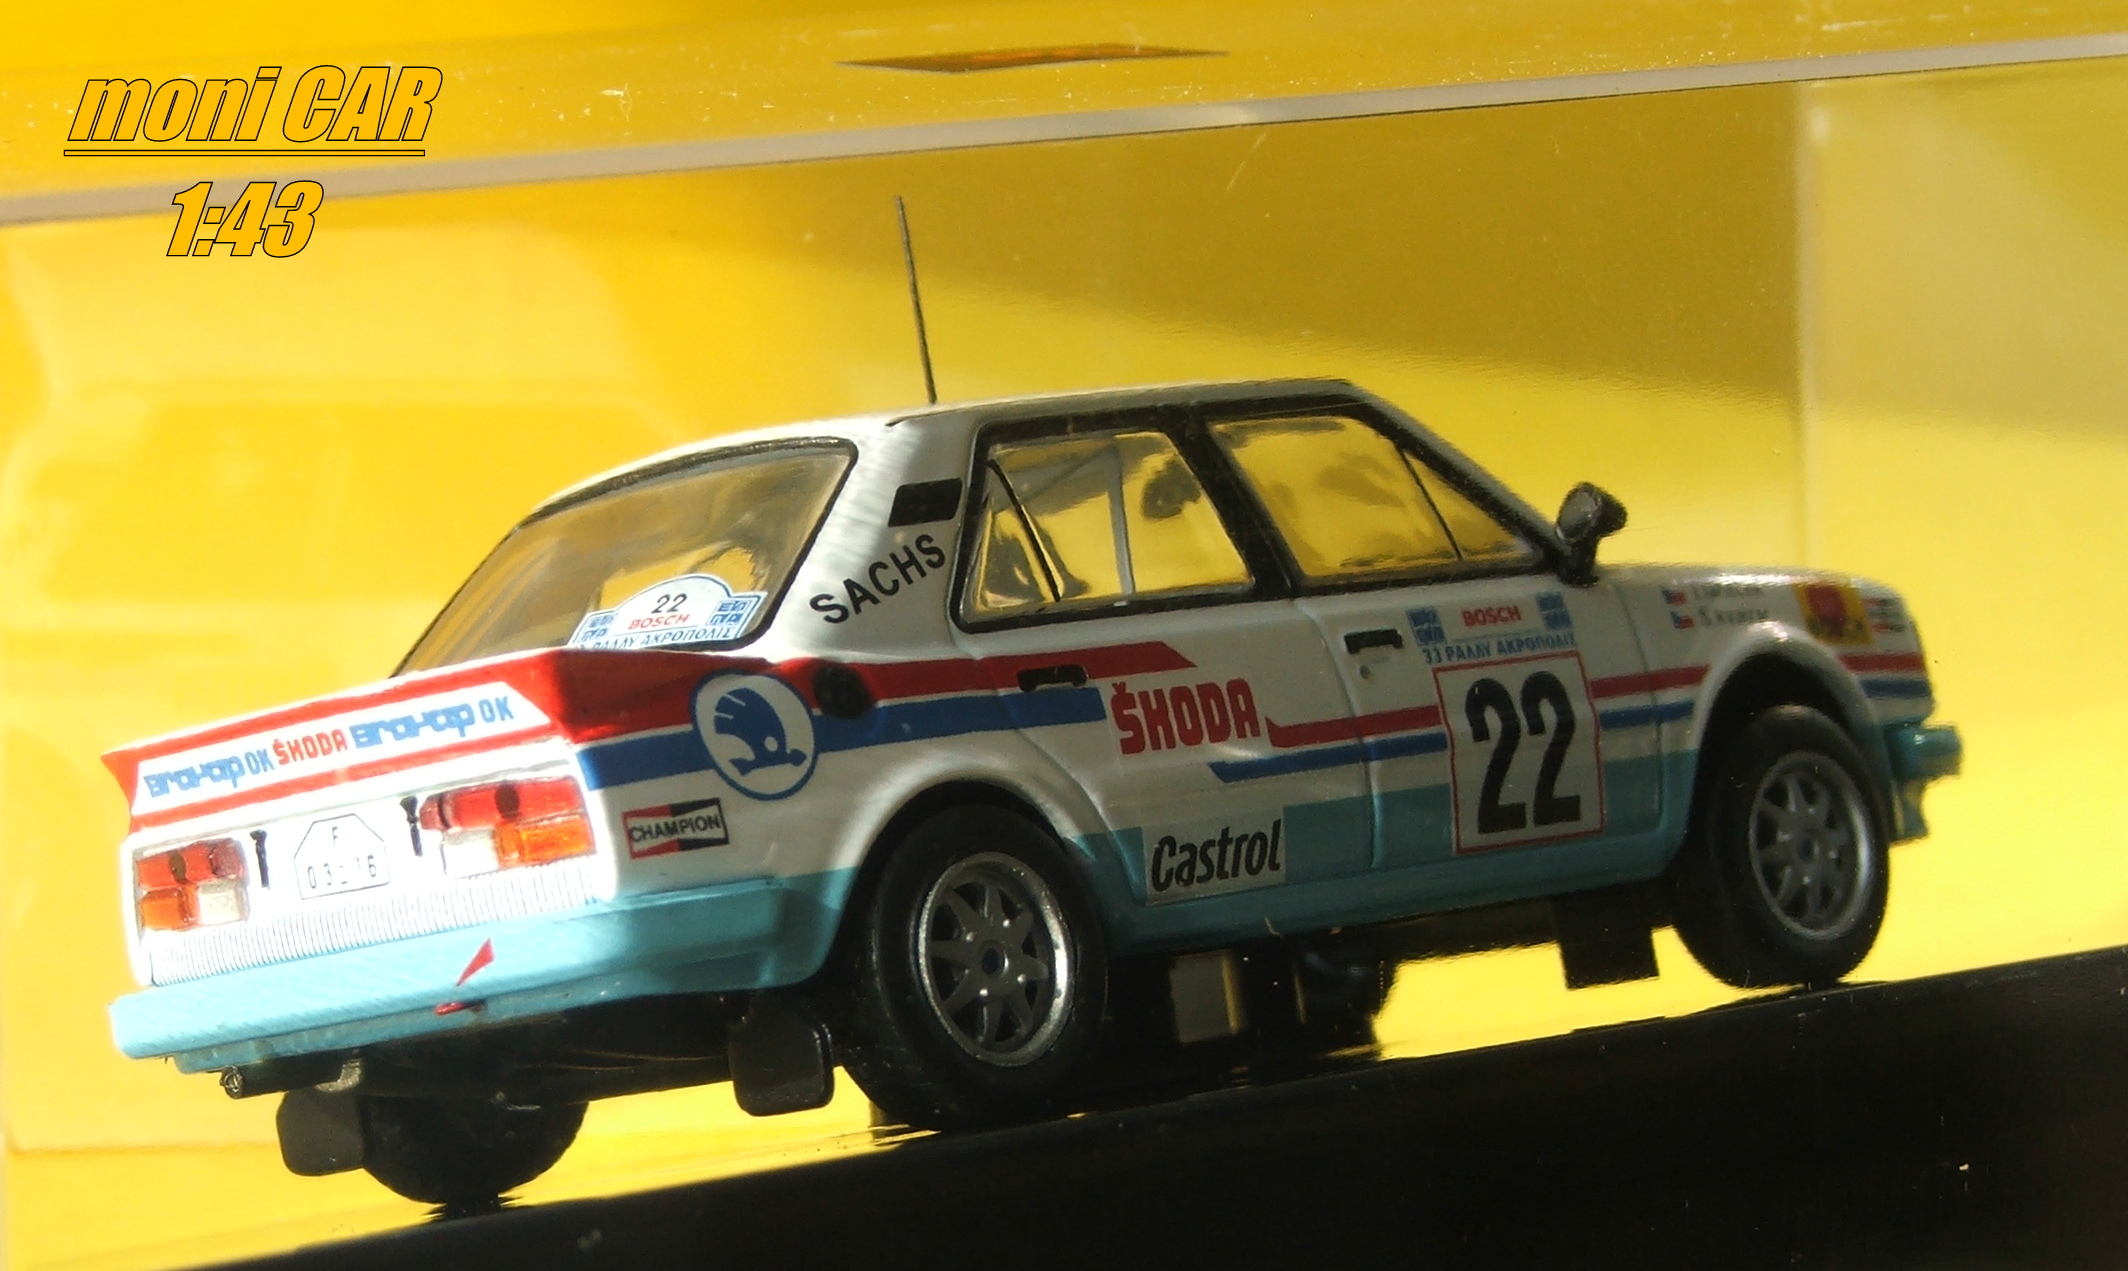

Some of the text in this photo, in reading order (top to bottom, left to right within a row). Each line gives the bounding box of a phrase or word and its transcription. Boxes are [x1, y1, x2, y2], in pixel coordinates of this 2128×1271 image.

[651, 593, 688, 613] 22
[809, 534, 946, 623] SACHS
[628, 613, 690, 631] BOSCH
[1461, 605, 1522, 627] BOSCH
[244, 748, 275, 776] OK
[272, 728, 348, 766] ŠKODA
[478, 695, 515, 723] OK
[1111, 677, 1261, 755] ŠKODA
[1465, 670, 1581, 834] 22
[629, 813, 721, 843] CHAMPION
[1151, 818, 1282, 892] Castrol
